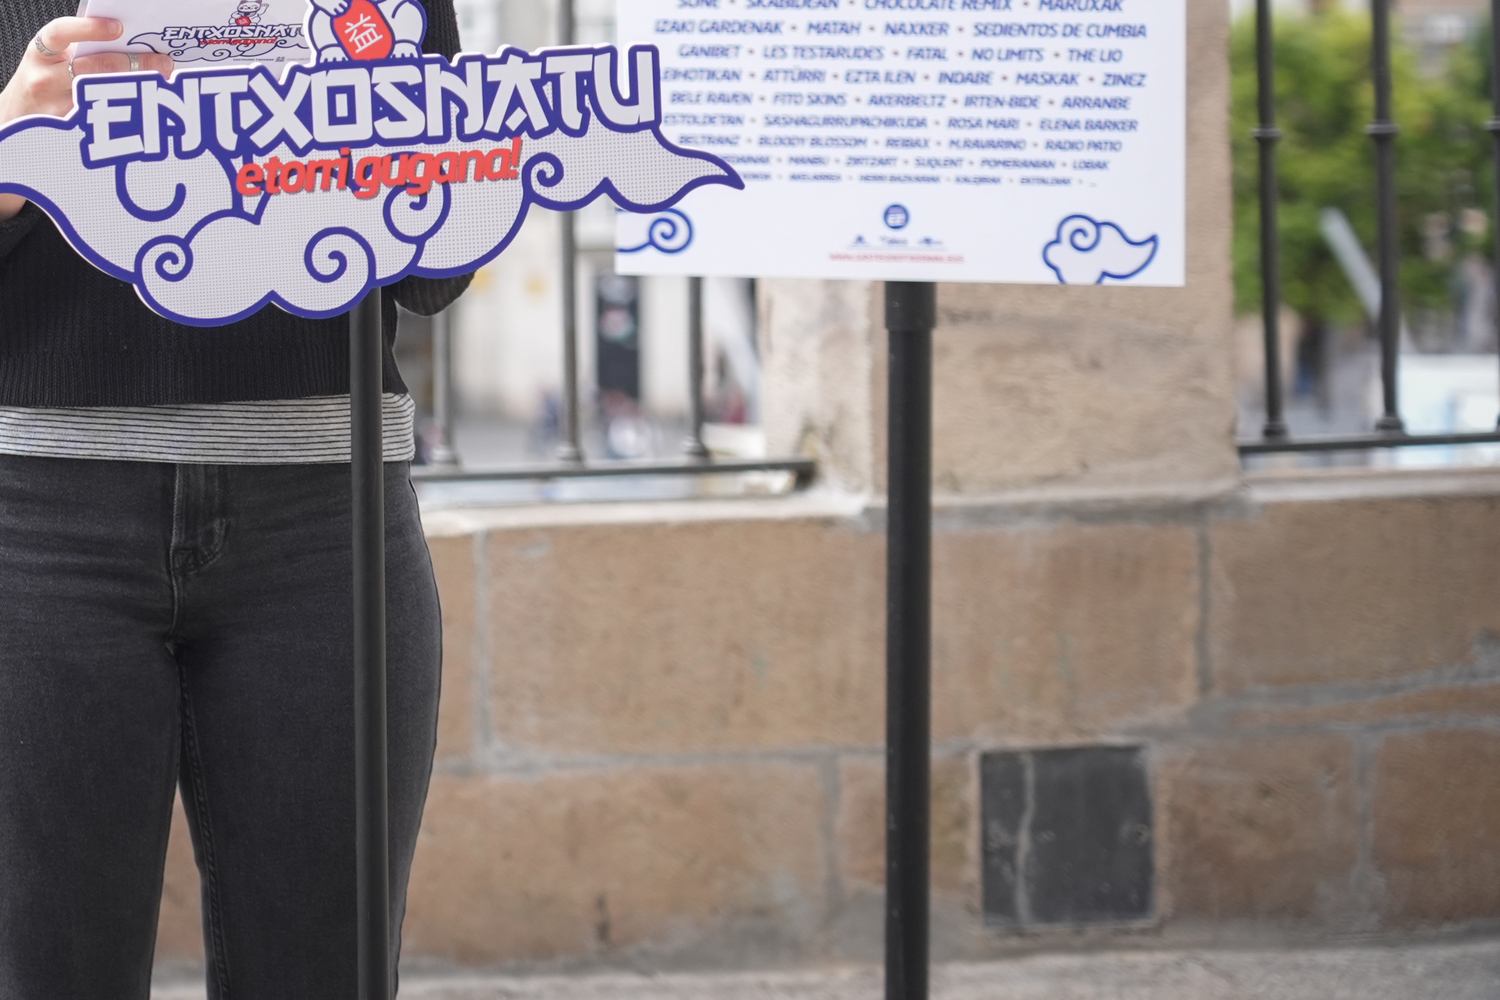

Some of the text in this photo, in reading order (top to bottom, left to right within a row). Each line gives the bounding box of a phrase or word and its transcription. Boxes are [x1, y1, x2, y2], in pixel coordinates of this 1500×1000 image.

[655, 19, 1147, 38] IZAKI GARDENAK MATAH NAXKER SEDIENTOS DE CUMBIA
[678, 44, 1123, 62] GANIBET LES TESTARUDES FATAL NO LIMITS THE LIO
[662, 68, 742, 82] EIHOTIKAN
[845, 69, 881, 83] EZTA
[884, 70, 916, 84] ILEN
[938, 71, 994, 85] INDABE
[1016, 72, 1080, 86] MASKAK
[1102, 73, 1147, 87] ZINEZ
[86, 44, 656, 160] ENTXOSNATU
[670, 92, 702, 105] BELE
[706, 92, 753, 106] RAVEN
[773, 93, 803, 106] FITO
[806, 93, 847, 107] SKINS
[868, 94, 946, 108] AKERBELTZ
[947, 117, 982, 130] ROSA
[986, 117, 1020, 130] MARI
[1040, 118, 1081, 131] ELENA
[1084, 119, 1138, 132] BARKER
[1045, 139, 1085, 151] RADIO
[1086, 140, 1122, 152] PATIO
[236, 137, 523, 199] etorri gugana!
